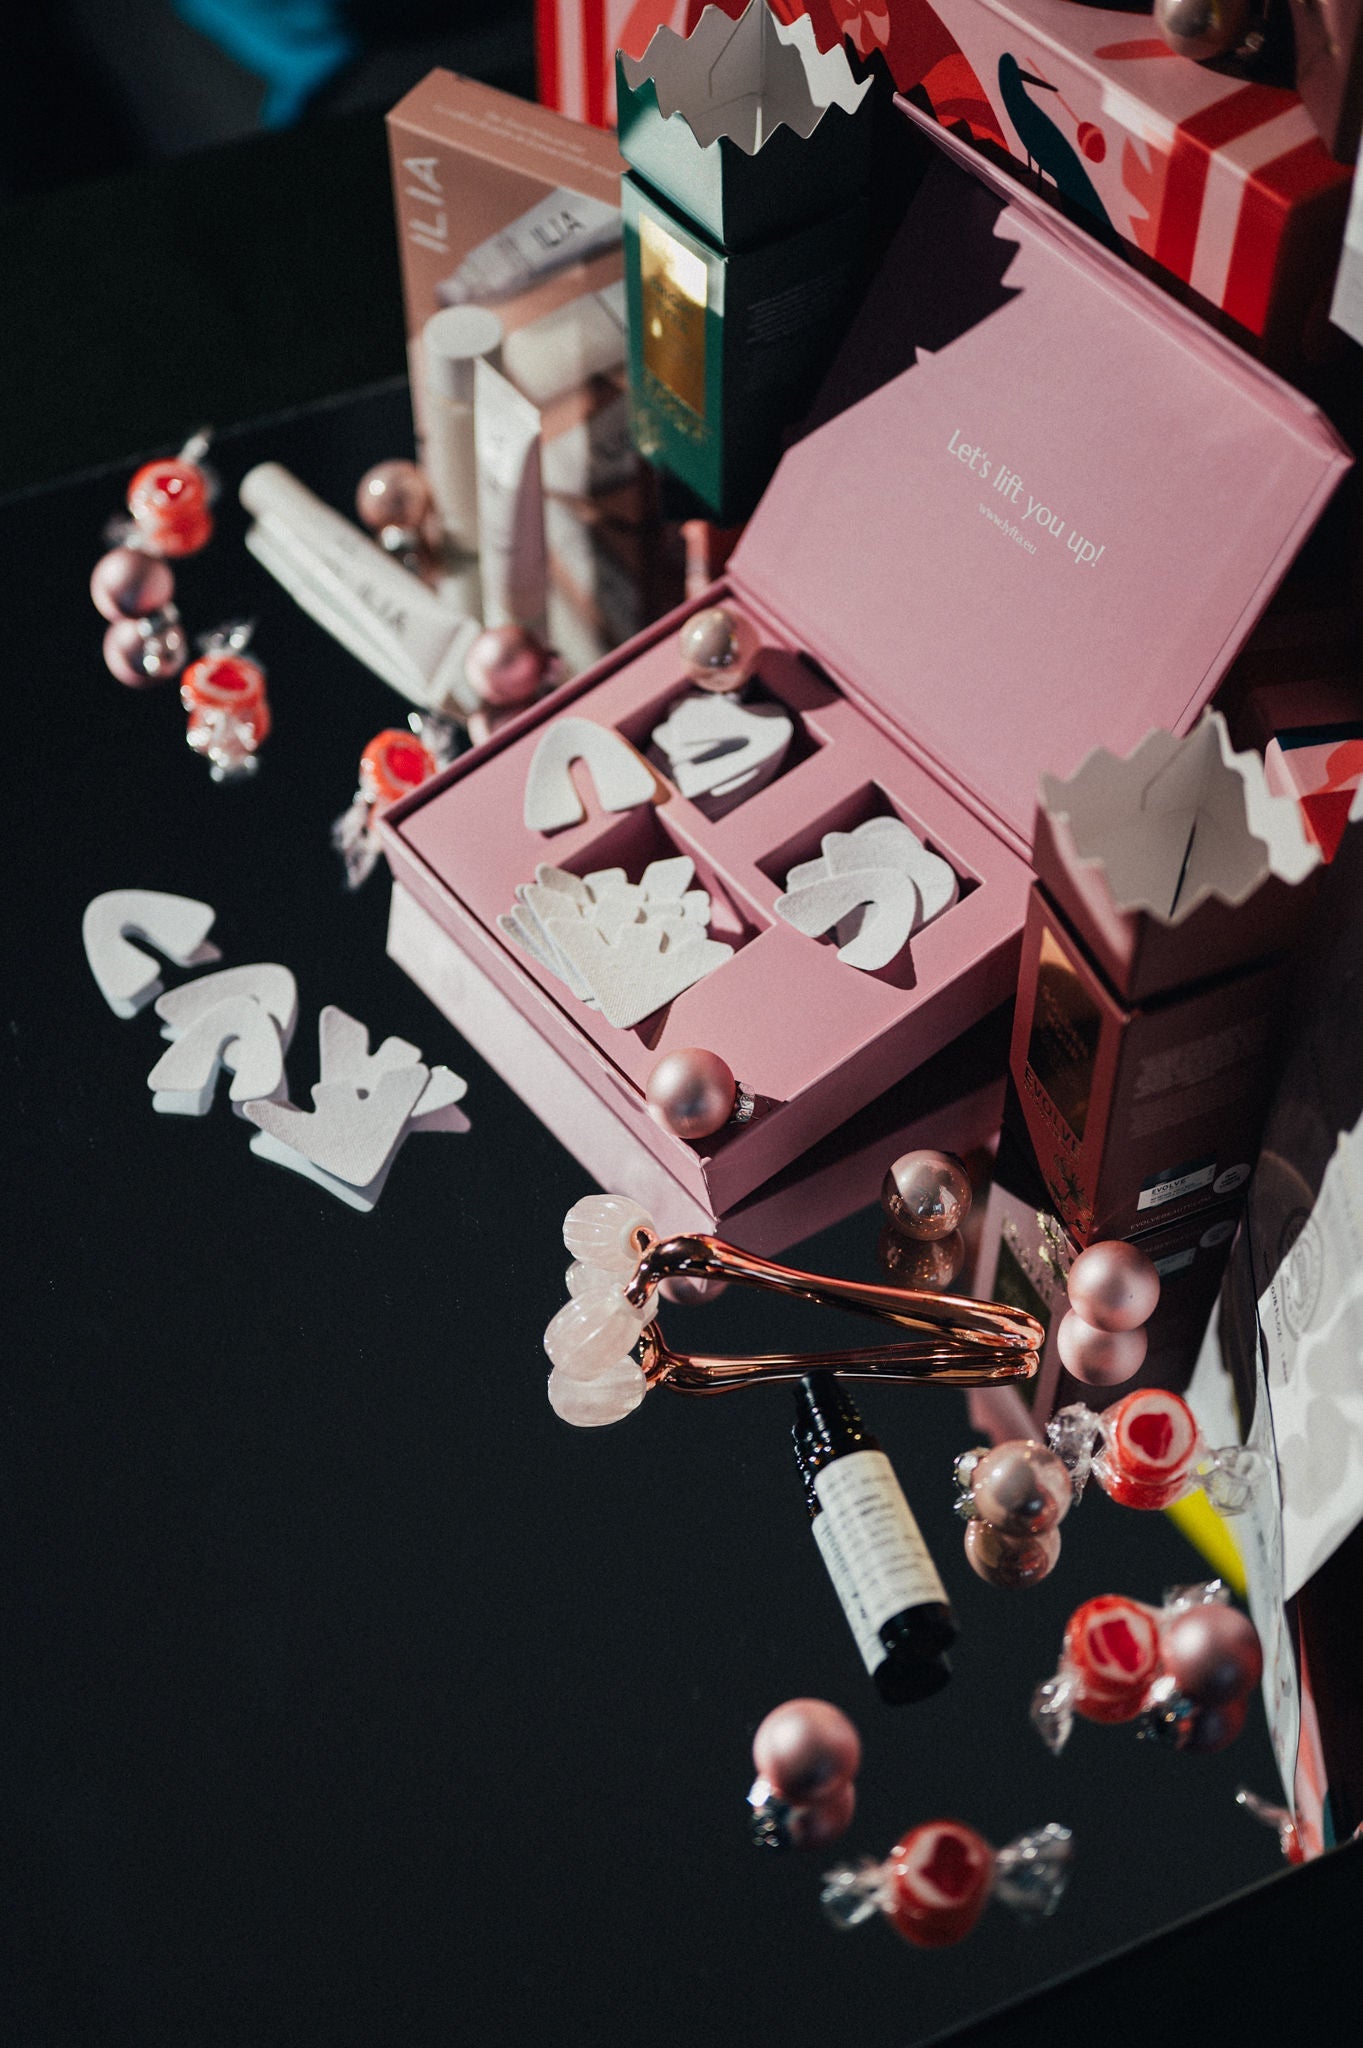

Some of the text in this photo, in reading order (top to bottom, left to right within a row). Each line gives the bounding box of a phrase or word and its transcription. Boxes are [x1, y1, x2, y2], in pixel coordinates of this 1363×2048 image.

[402, 156, 449, 254] ILIA
[529, 210, 584, 249] ILIA
[992, 464, 1025, 504] lift
[1020, 495, 1066, 539] you
[1066, 530, 1106, 568] up!
[1151, 1178, 1187, 1195] EVOLVE
